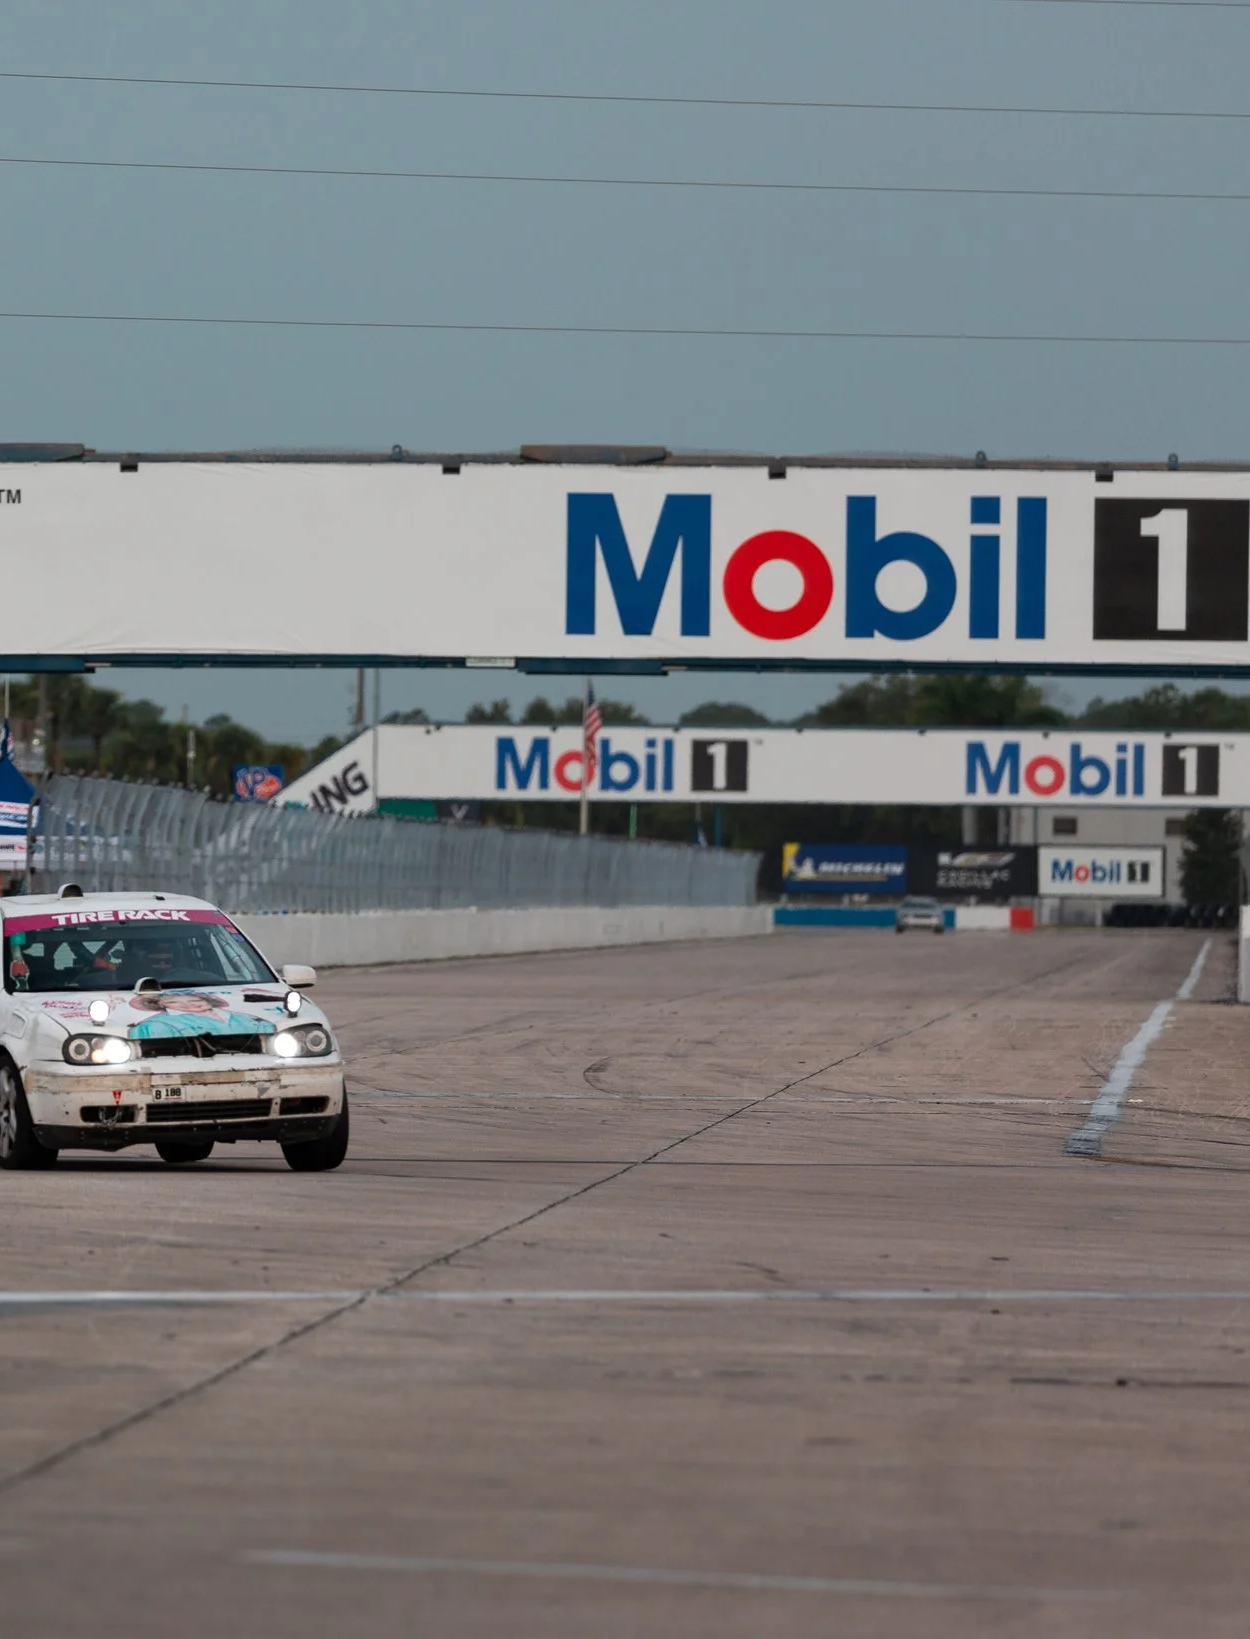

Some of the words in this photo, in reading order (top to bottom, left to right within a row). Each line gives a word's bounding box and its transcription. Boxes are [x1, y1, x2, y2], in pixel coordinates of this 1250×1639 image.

[566, 492, 1047, 640] Mobil
[1140, 508, 1188, 631] 1
[496, 737, 674, 792] Mobil
[707, 742, 727, 790] 1
[966, 741, 1145, 796] Mobil
[1178, 747, 1198, 794] 1
[1051, 858, 1121, 884] Mobil
[51, 911, 116, 926] TIRE
[117, 909, 190, 922] RACK
